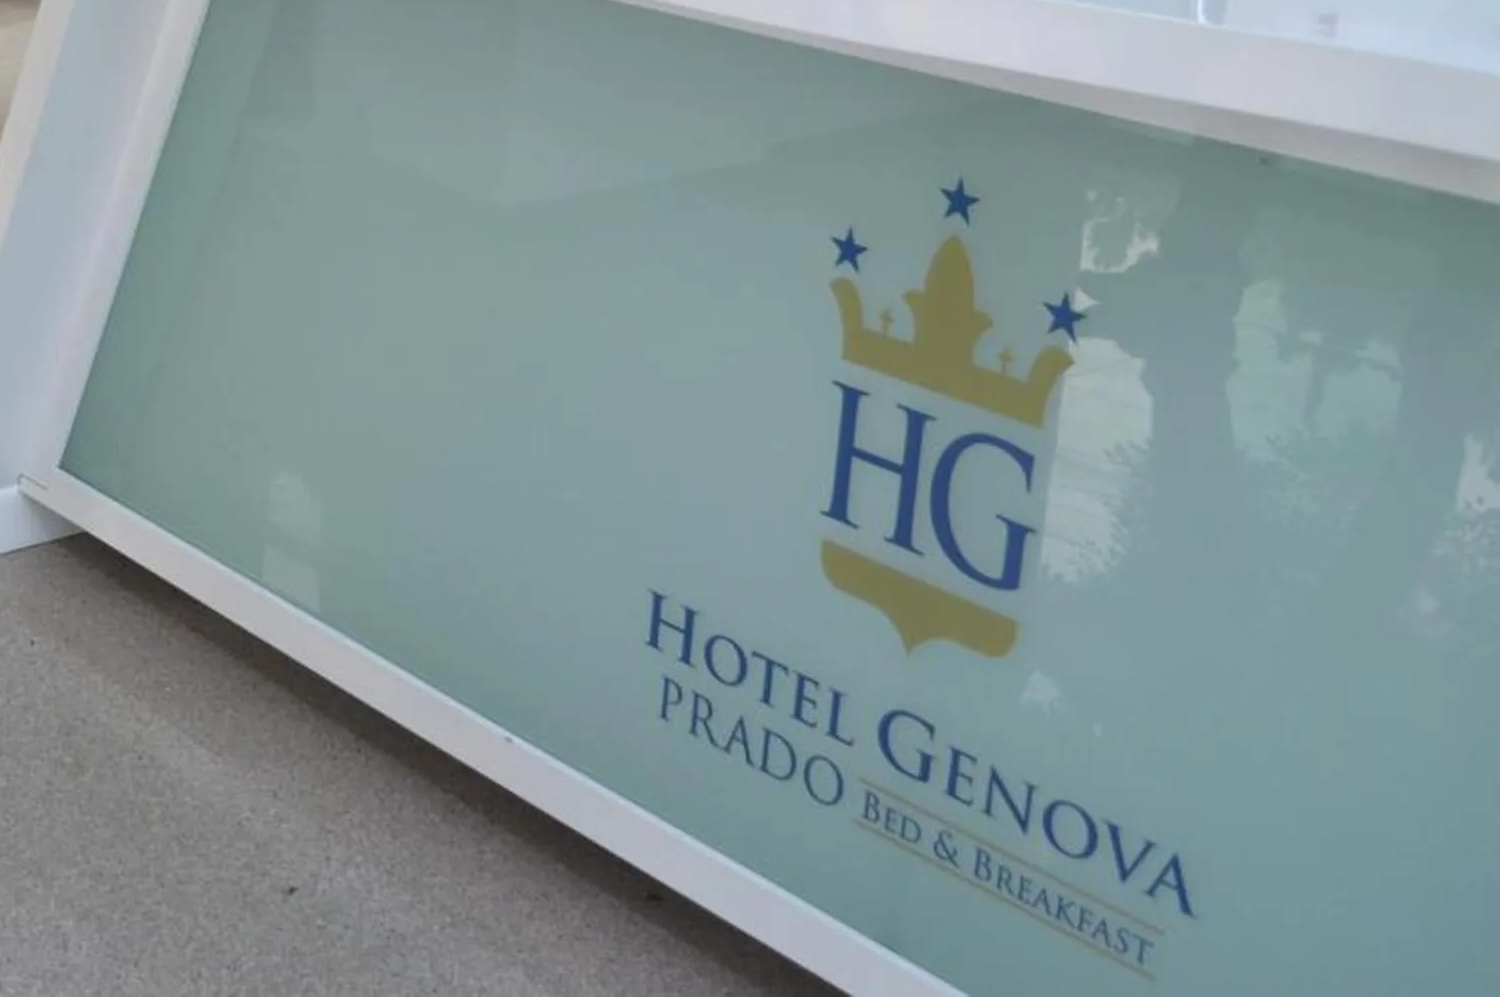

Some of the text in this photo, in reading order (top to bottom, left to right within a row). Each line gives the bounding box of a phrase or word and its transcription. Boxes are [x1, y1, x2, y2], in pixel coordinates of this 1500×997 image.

[820, 380, 1039, 592] HG
[645, 589, 1197, 920] HOTEL GENOVA
[659, 676, 1156, 967] PRADO BED & BREAKFAST
